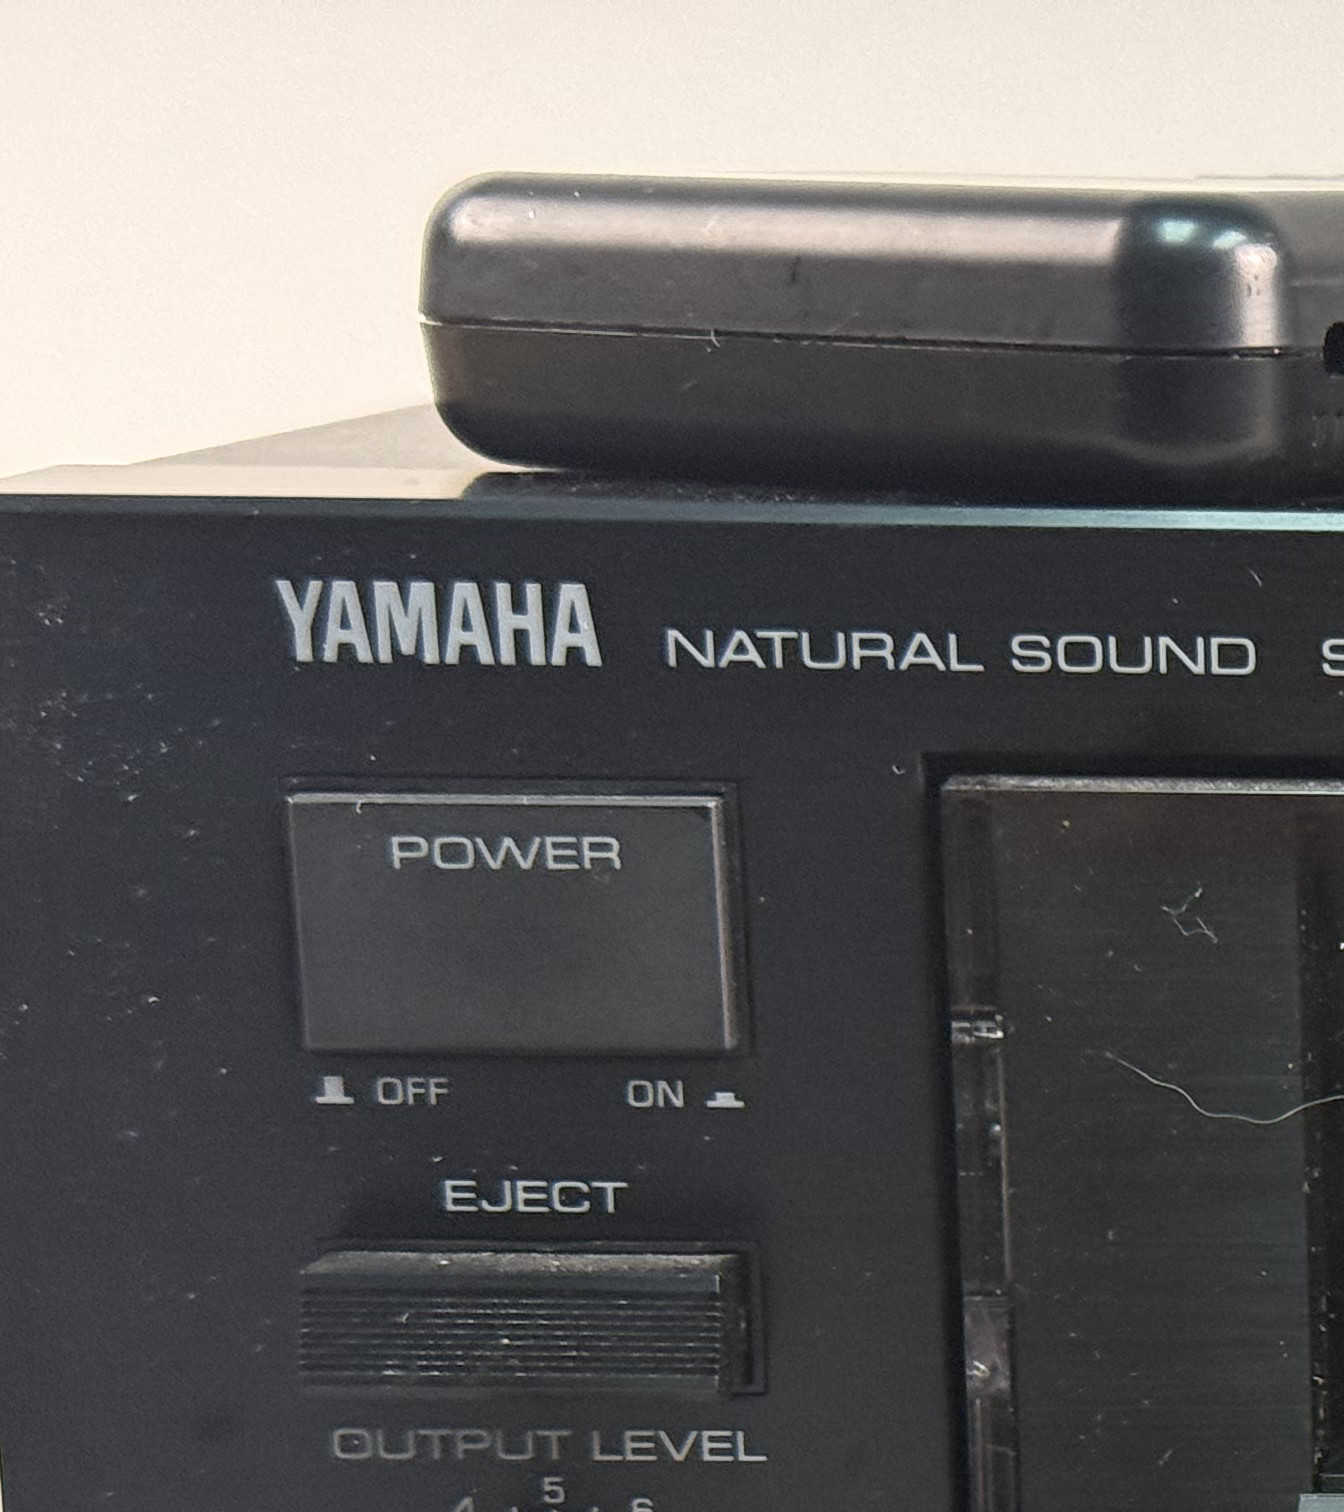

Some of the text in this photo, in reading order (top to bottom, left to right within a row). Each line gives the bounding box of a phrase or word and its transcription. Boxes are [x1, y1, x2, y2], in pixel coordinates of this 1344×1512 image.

[274, 579, 603, 667] YAMAHA
[666, 628, 985, 672] NATURAL
[1010, 634, 1257, 676] SOUND
[390, 835, 622, 870] POWER
[374, 1076, 449, 1105] OFF
[626, 1080, 684, 1108] ON
[442, 1179, 629, 1213] EJECT
[329, 1427, 768, 1462] OUTPUT LEVEL
[542, 1476, 565, 1504] 5
